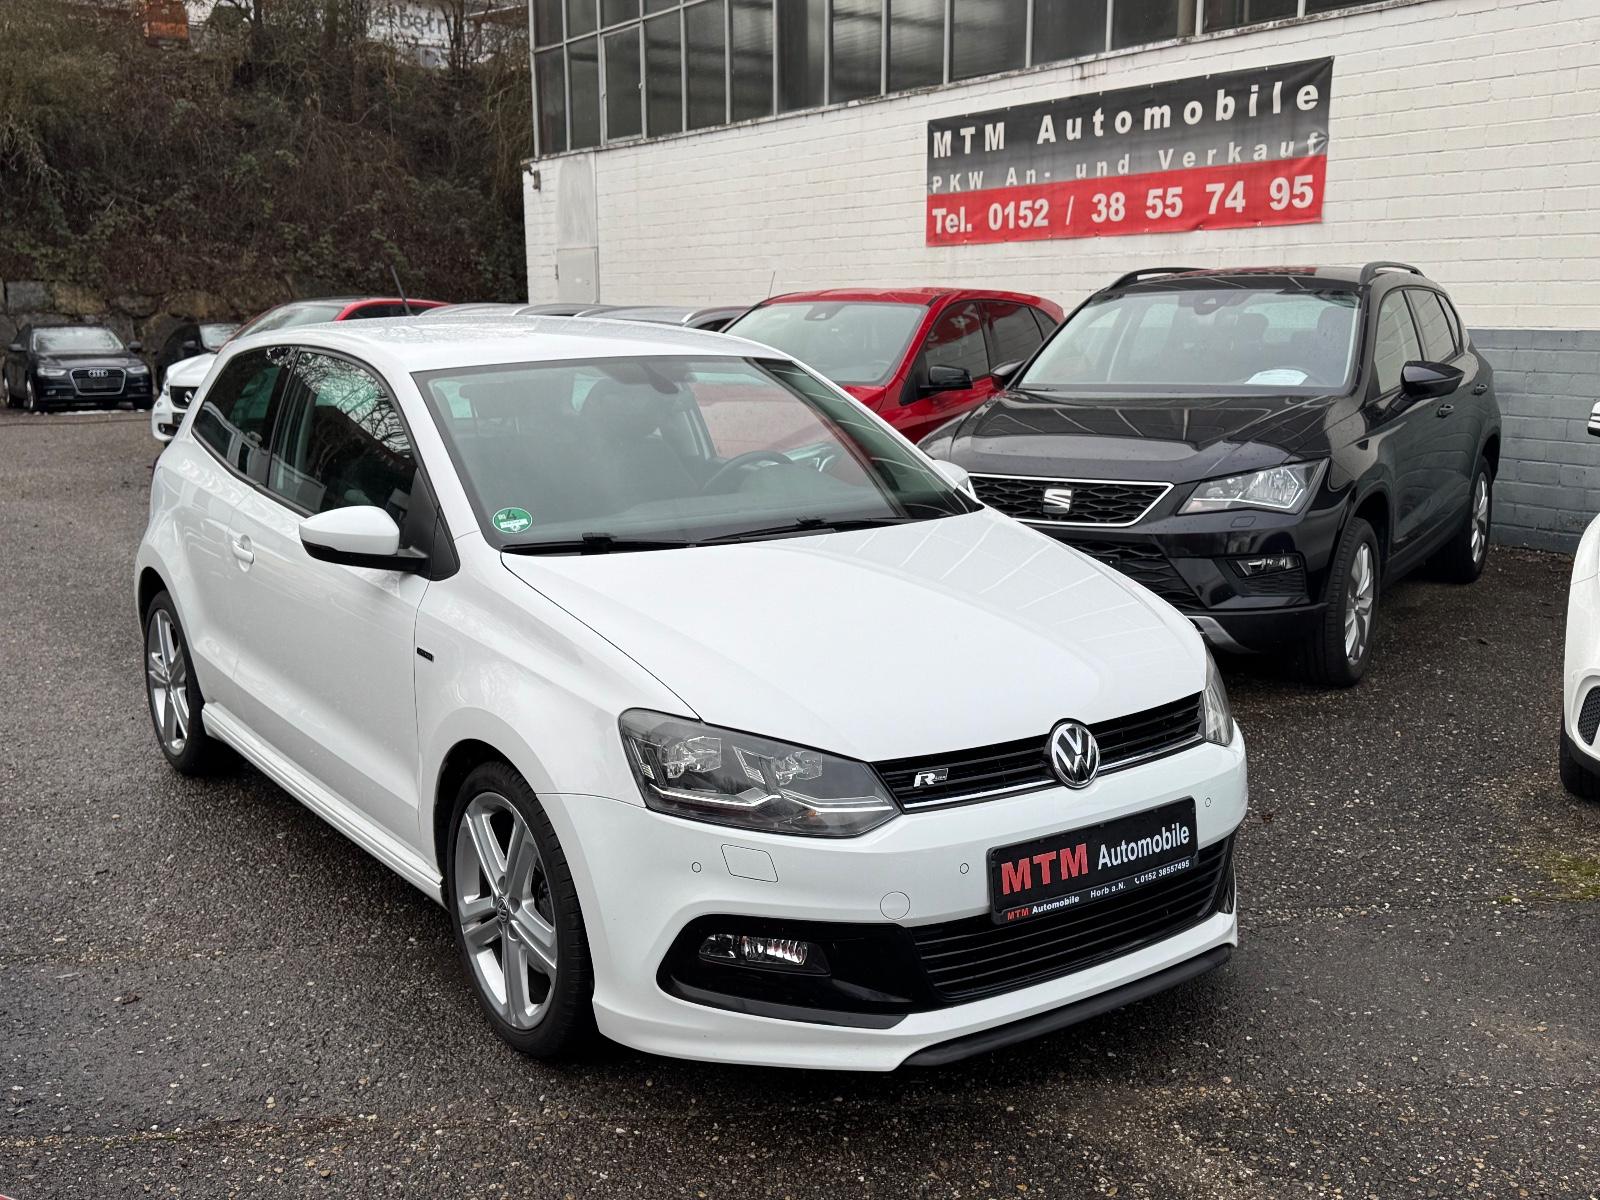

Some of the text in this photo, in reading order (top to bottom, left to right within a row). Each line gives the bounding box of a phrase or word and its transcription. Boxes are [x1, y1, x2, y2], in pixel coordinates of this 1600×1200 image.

[933, 81, 1319, 158] MTM Automobile
[932, 132, 1318, 193] PKW An- und Verkauf
[932, 206, 973, 234] Tel.
[988, 198, 1049, 231] 0152
[1091, 192, 1126, 223] 38
[1145, 186, 1183, 219] 55
[1205, 181, 1246, 215] 74
[1269, 174, 1314, 211] 95
[1001, 823, 1190, 895] MTM Automobile
[1007, 908, 1029, 920] MTM
[1032, 895, 1080, 914] Automobile
[1090, 886, 1109, 898] Horb
[1140, 872, 1157, 882] 0152
